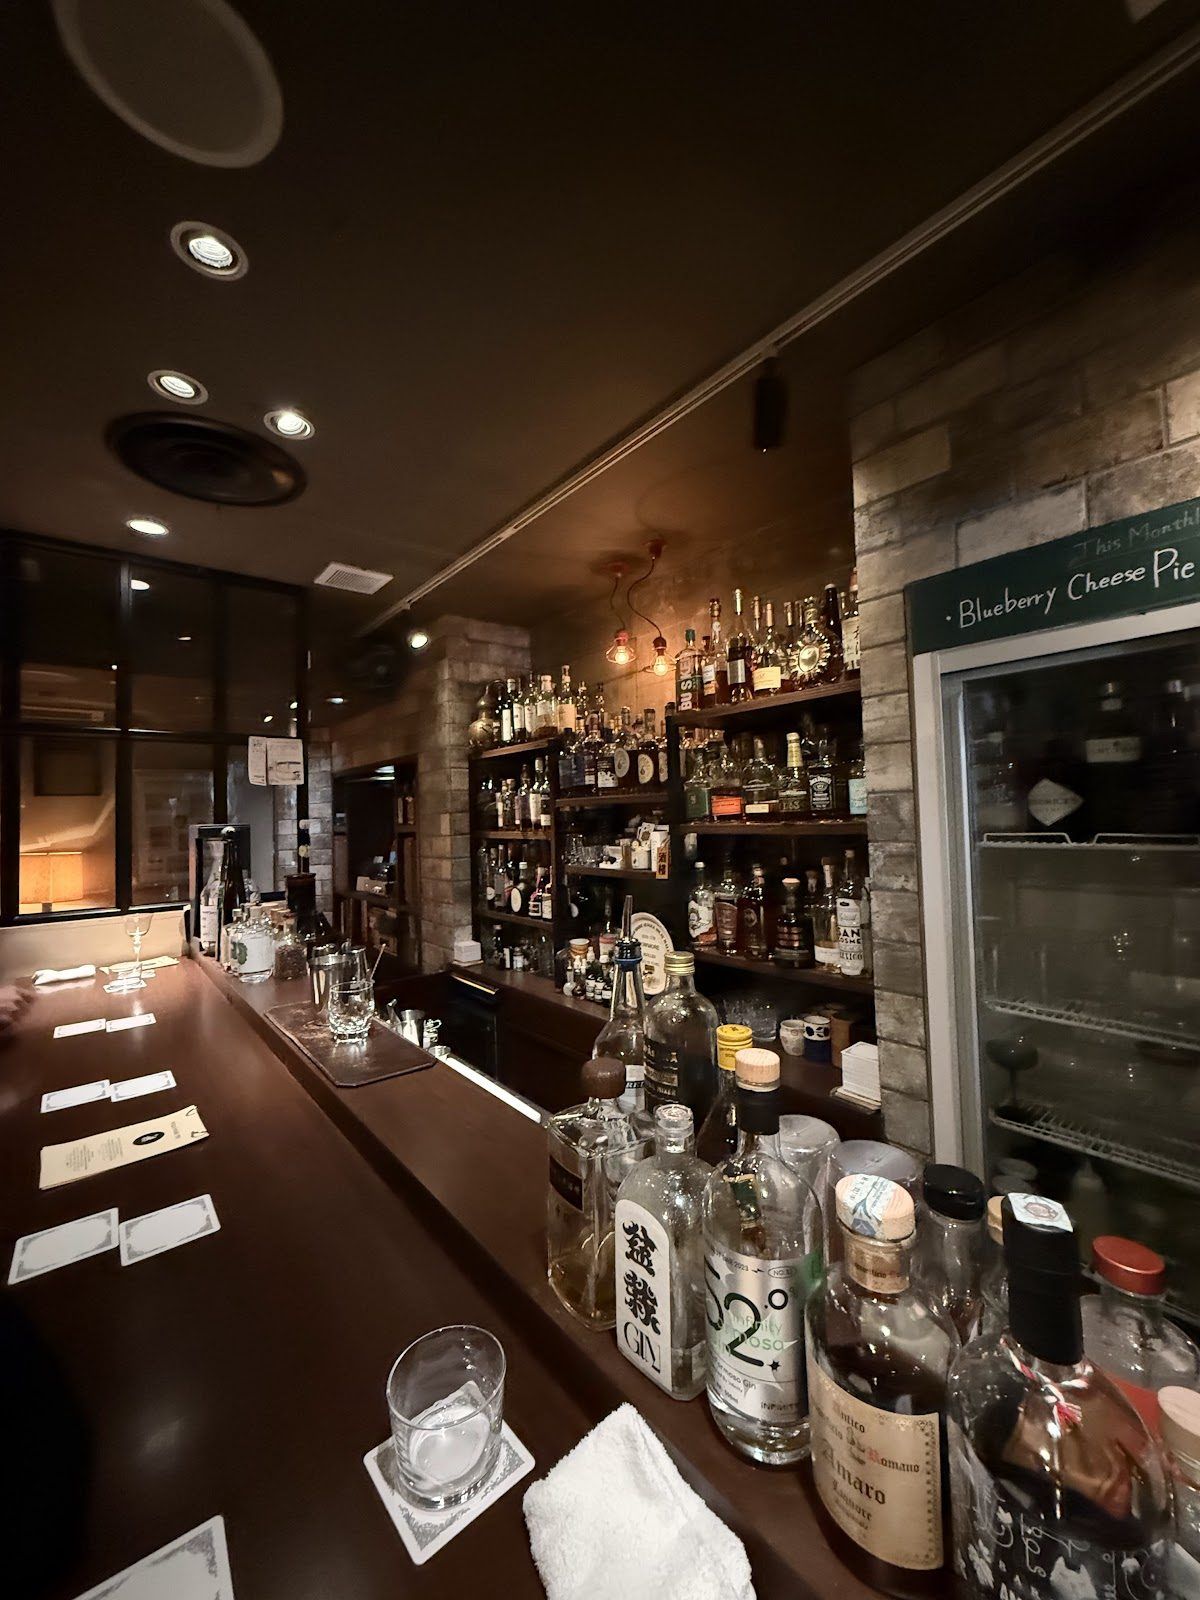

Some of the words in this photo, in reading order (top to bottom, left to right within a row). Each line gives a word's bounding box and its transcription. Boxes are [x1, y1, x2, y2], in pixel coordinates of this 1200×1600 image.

[1072, 538, 1121, 558] This
[1128, 507, 1200, 547] Monthl
[959, 587, 1057, 629] Blueberry
[1067, 566, 1146, 600] Cheese
[1153, 548, 1196, 588] Pie
[624, 1321, 661, 1374] GIN
[821, 1438, 886, 1505] Amaro
[867, 1446, 920, 1473] Romano
